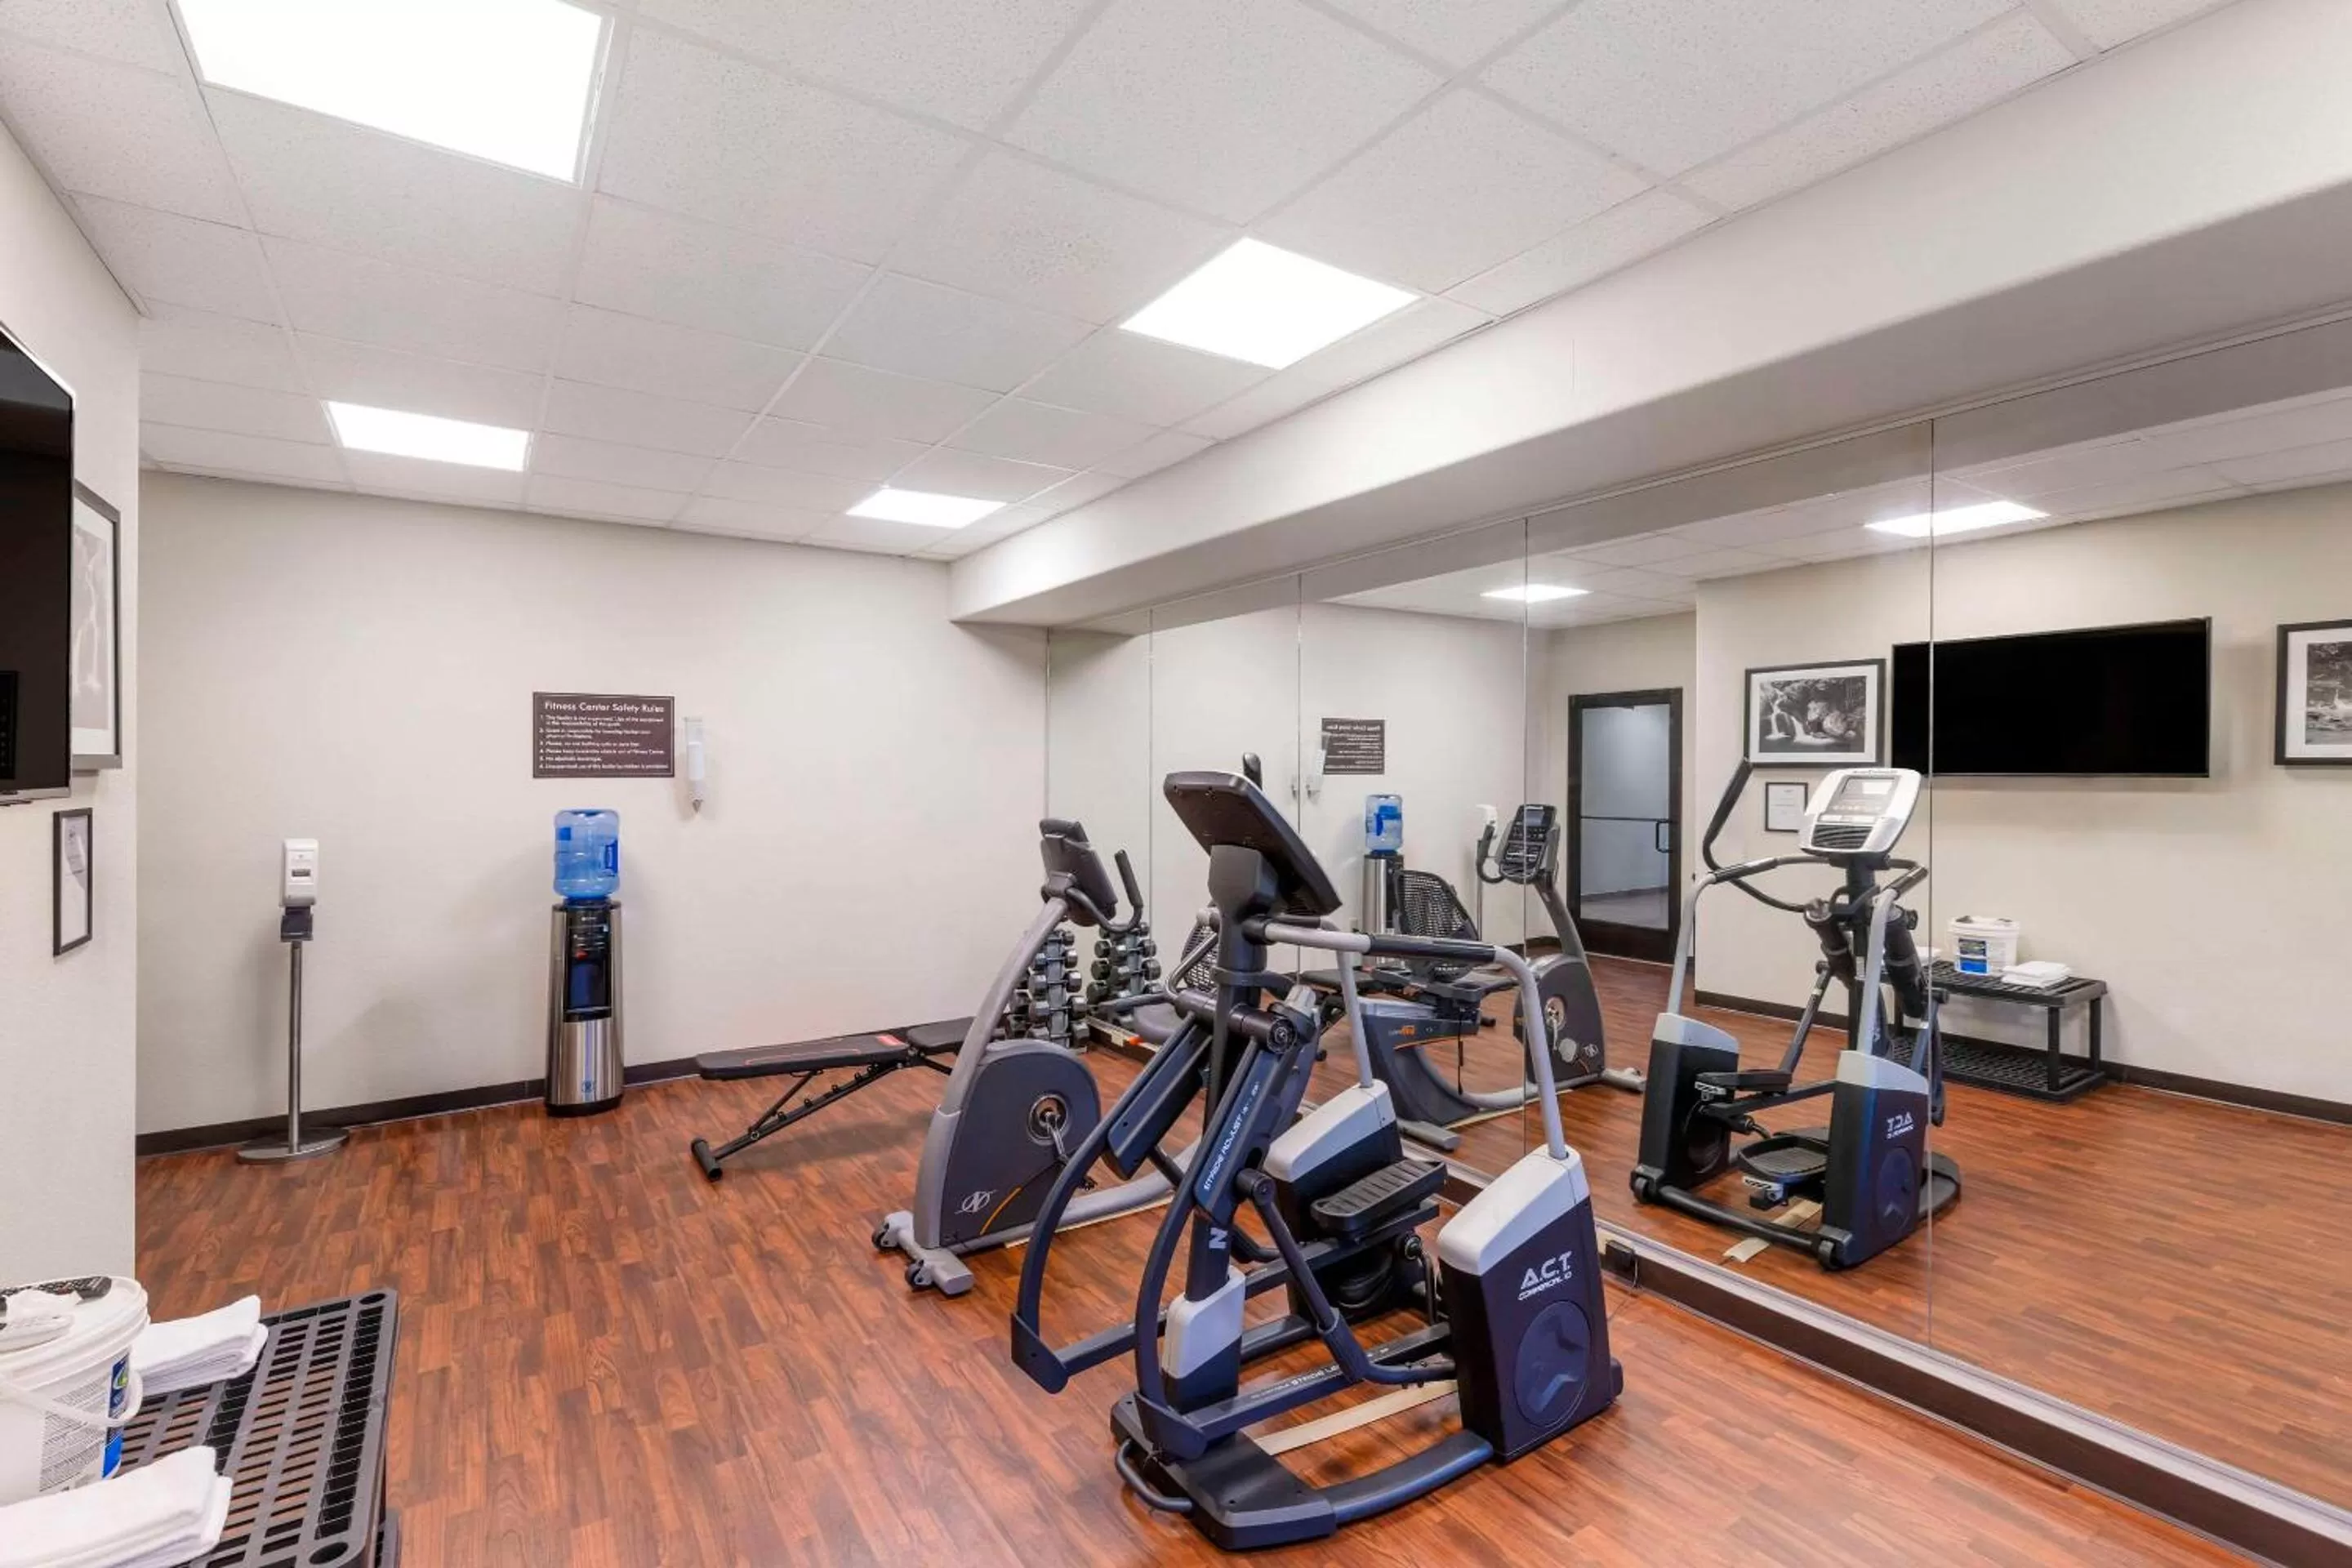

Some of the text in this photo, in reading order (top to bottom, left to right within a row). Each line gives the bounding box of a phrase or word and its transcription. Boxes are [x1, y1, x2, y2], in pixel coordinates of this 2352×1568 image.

[544, 702, 577, 711] Fitness
[579, 702, 611, 712] Center
[612, 703, 640, 714] Safety
